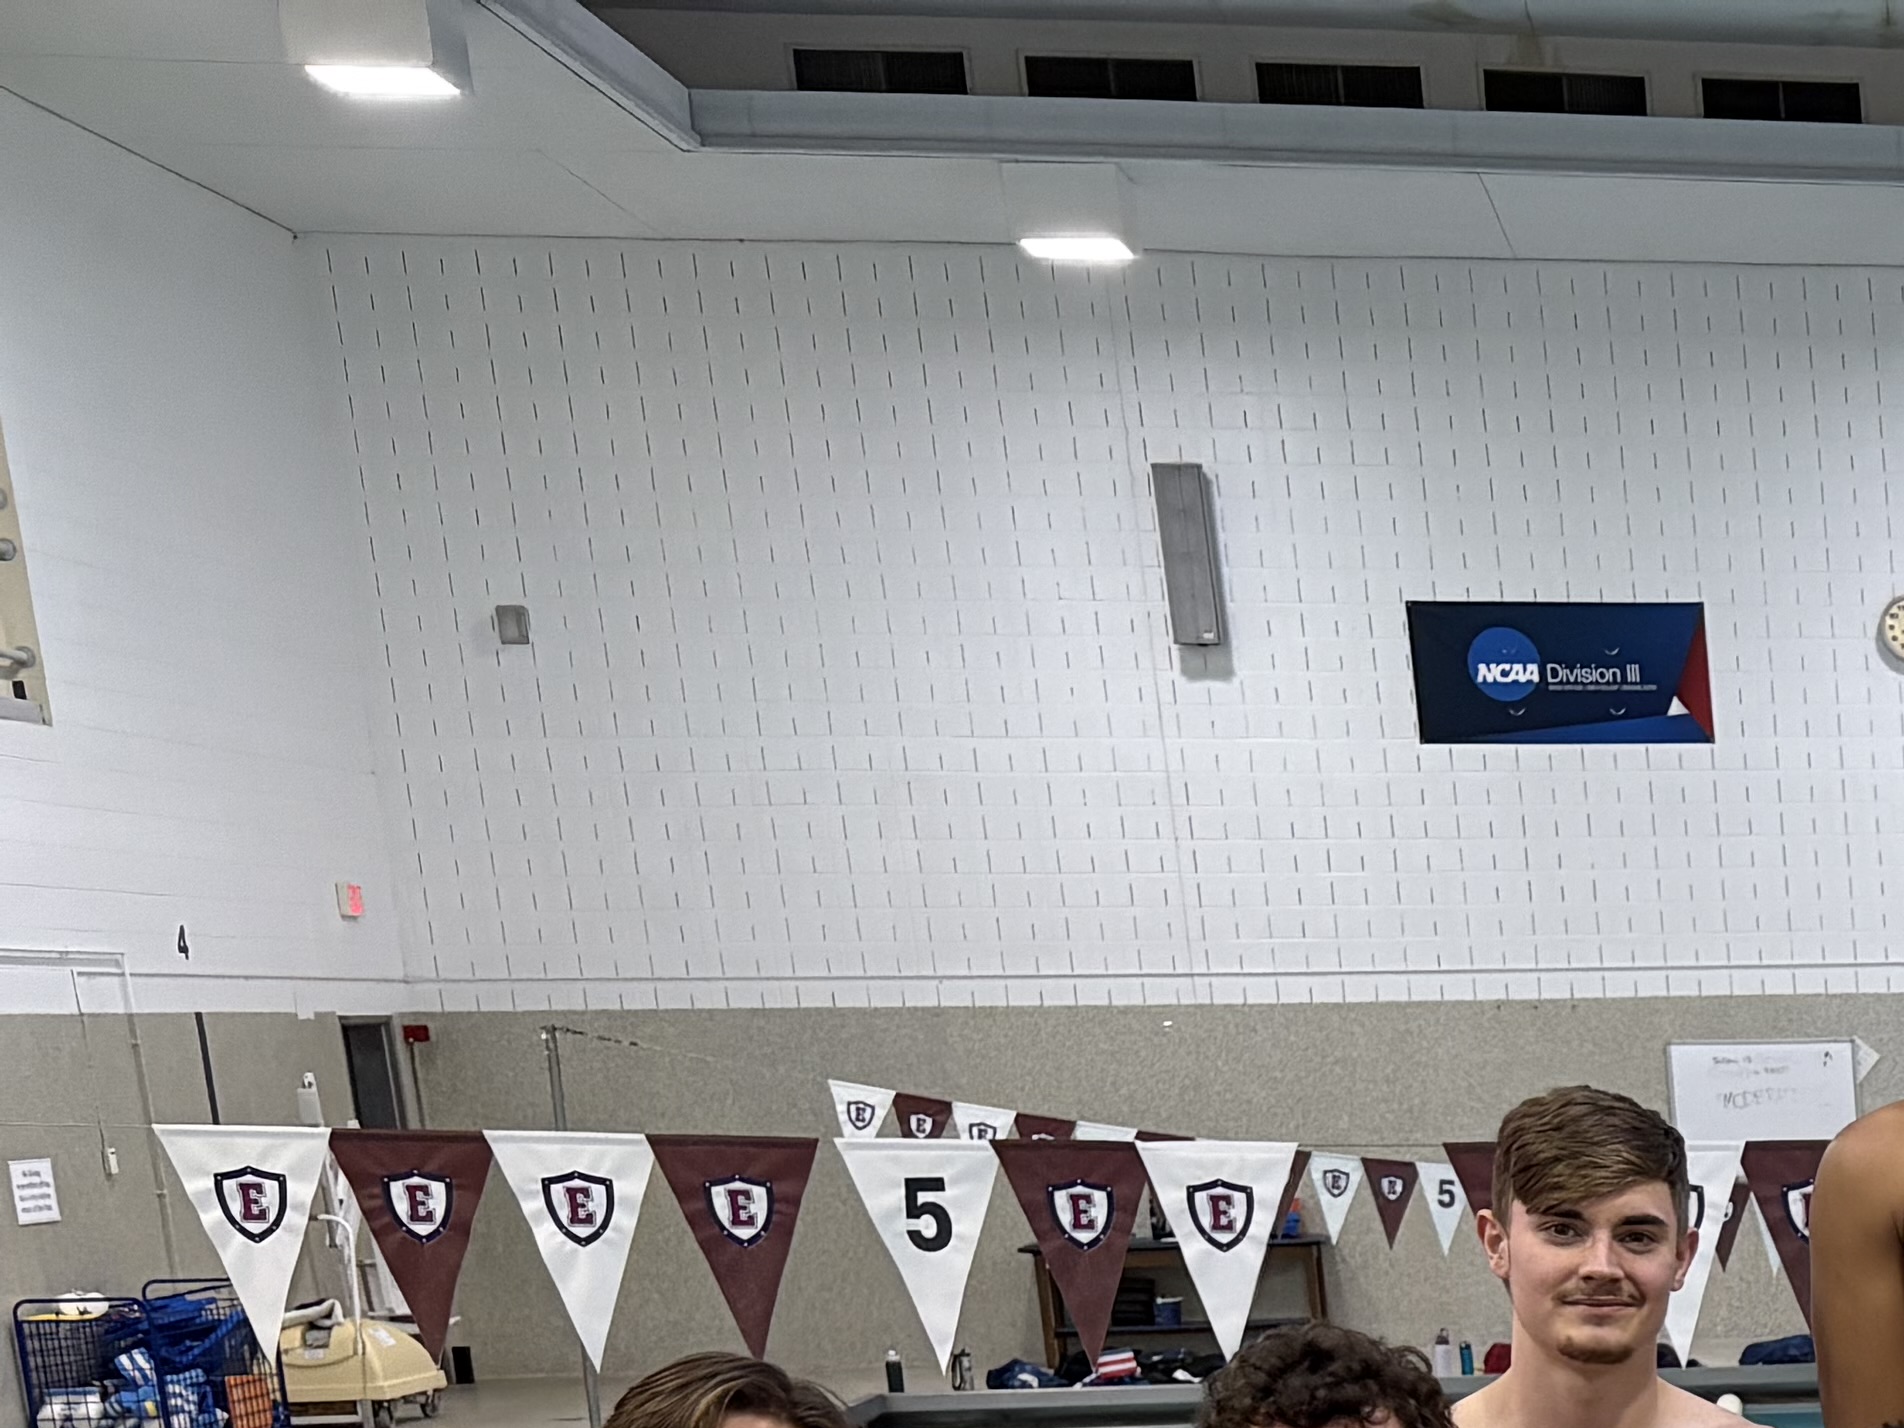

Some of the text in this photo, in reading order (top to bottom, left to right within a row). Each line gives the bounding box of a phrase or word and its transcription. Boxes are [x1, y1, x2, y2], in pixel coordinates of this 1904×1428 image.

[1477, 663, 1640, 683] NCAA Division III
[235, 1181, 270, 1224] E
[401, 1183, 436, 1225] E
[562, 1186, 596, 1228] E
[725, 1187, 758, 1230] E
[903, 1176, 952, 1253] 5
[1067, 1191, 1098, 1232] E
[1206, 1193, 1237, 1234] E
[1437, 1179, 1456, 1208] 5
